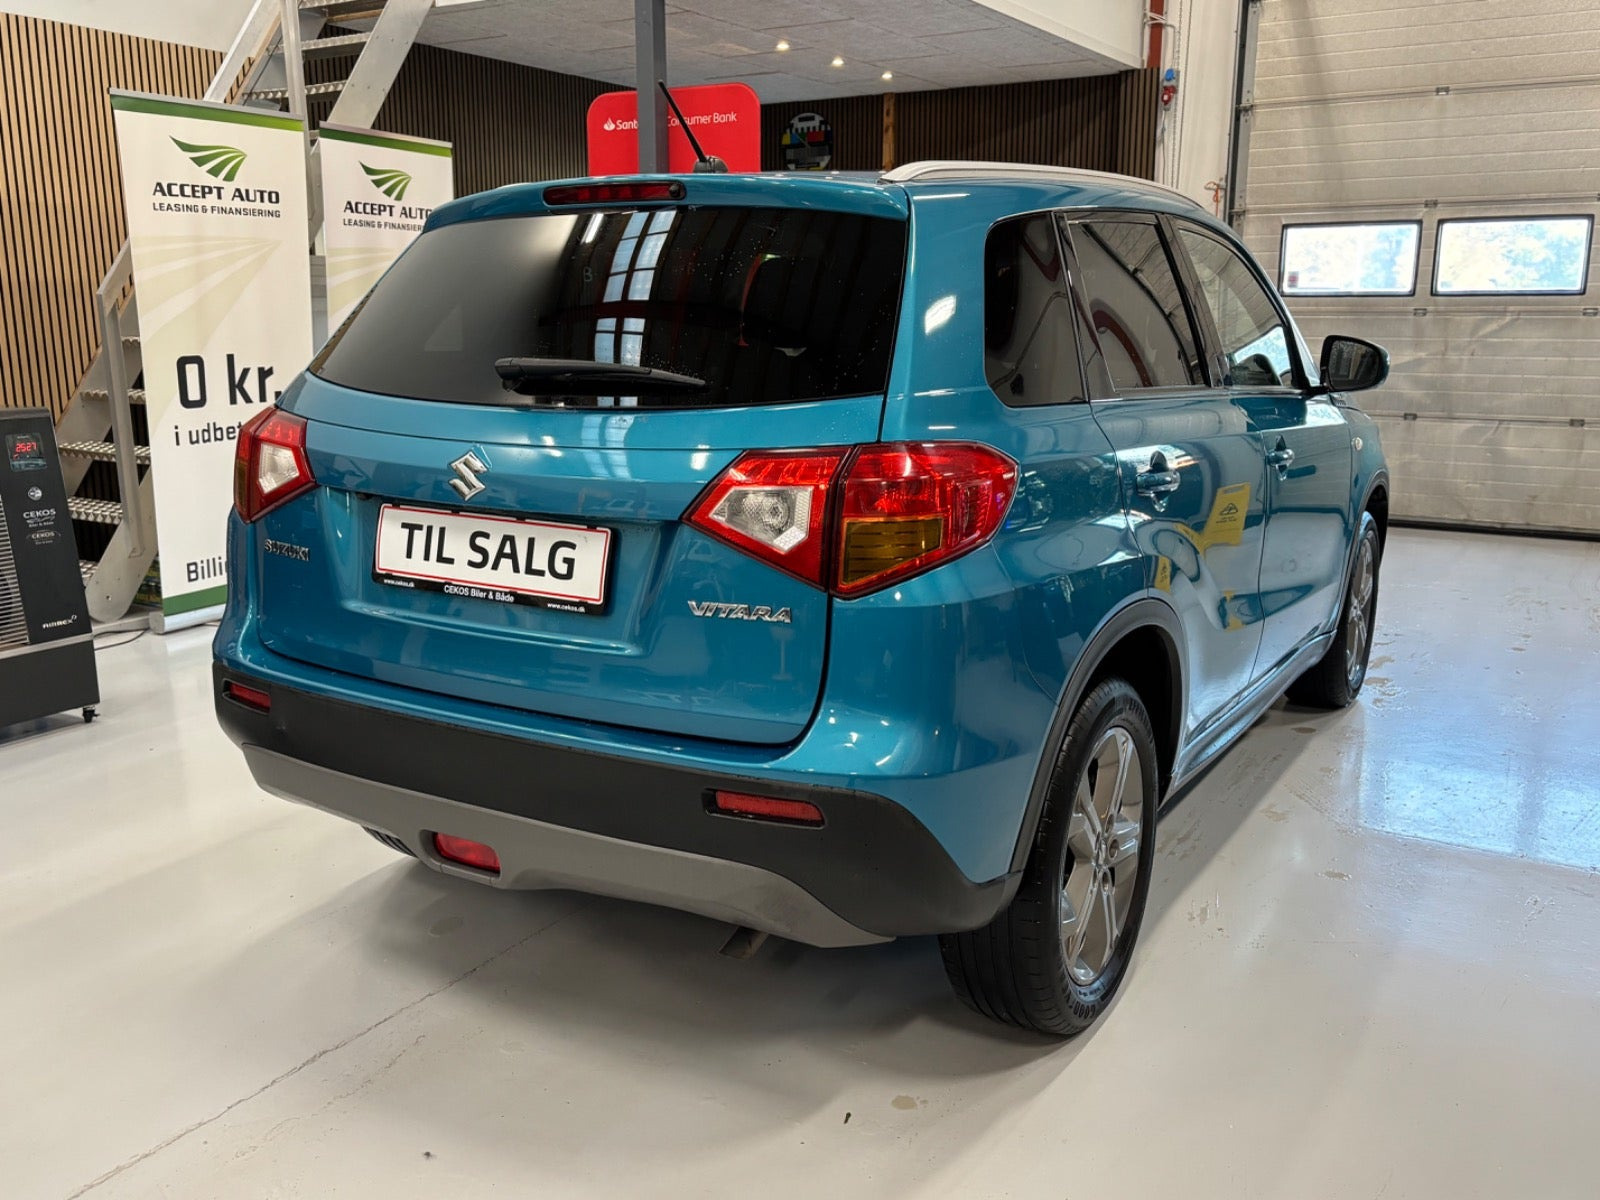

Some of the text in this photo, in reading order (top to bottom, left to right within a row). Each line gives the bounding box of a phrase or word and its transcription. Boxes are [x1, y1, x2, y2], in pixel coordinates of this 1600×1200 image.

[713, 111, 737, 123] Bank
[152, 182, 280, 204] ACCEPT AUTO
[152, 202, 281, 218] LEASING & FINANSIERING
[343, 200, 395, 217] ACCEPT
[343, 218, 376, 228] LEASING
[384, 221, 422, 232] FINANSIER
[176, 353, 282, 409] 0 kr.
[174, 421, 243, 446] i udbe
[22, 508, 57, 519] CEKOS
[264, 539, 310, 561] SUZUKI
[401, 522, 577, 580] TIL SALG
[186, 556, 227, 583] Billi
[444, 584, 515, 603] CEKOS Biler & Både
[547, 602, 586, 613] www.cekos.dk
[687, 600, 792, 623] VITARA
